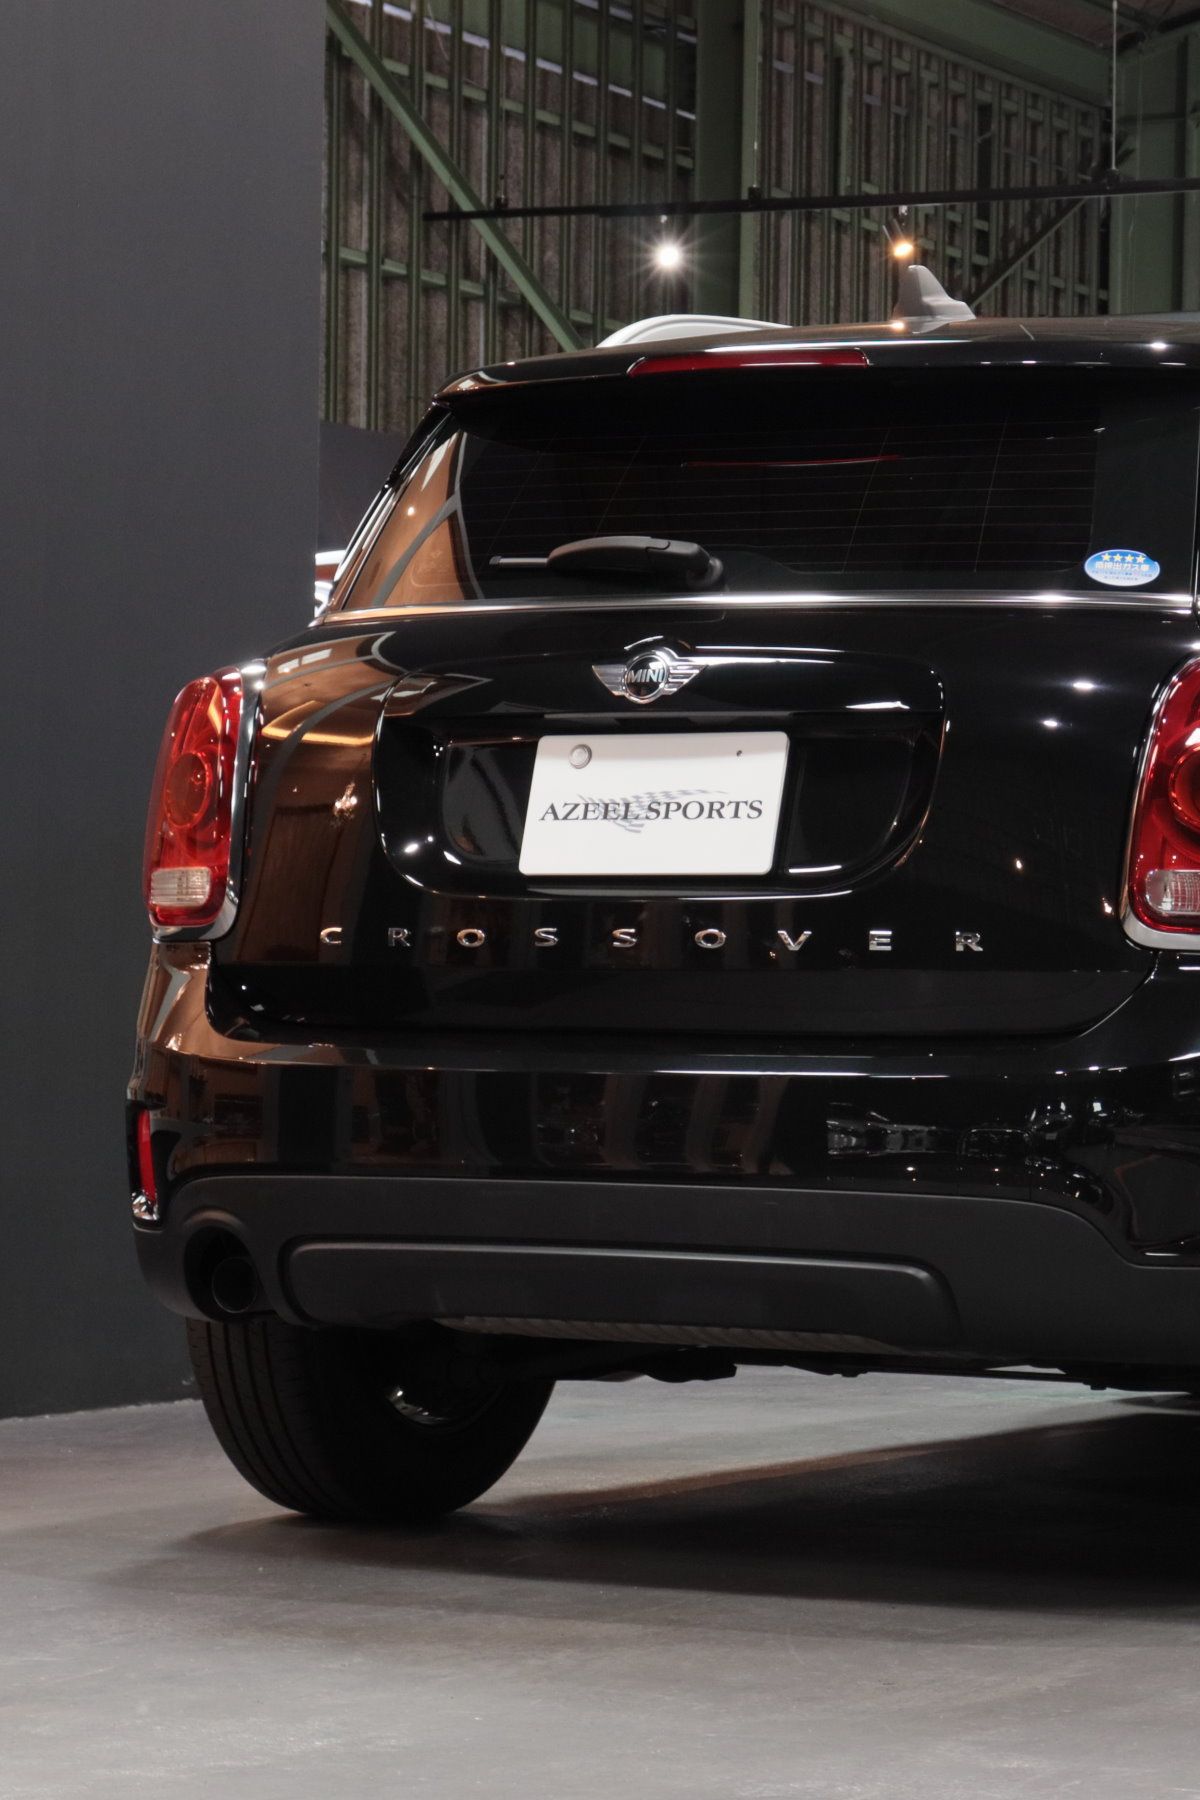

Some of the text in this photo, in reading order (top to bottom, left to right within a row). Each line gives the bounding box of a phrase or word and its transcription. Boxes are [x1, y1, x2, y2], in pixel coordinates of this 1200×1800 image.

[627, 668, 664, 683] MINI
[541, 799, 764, 821] AZEEL SPORTS
[319, 926, 984, 952] CROSSOVER
